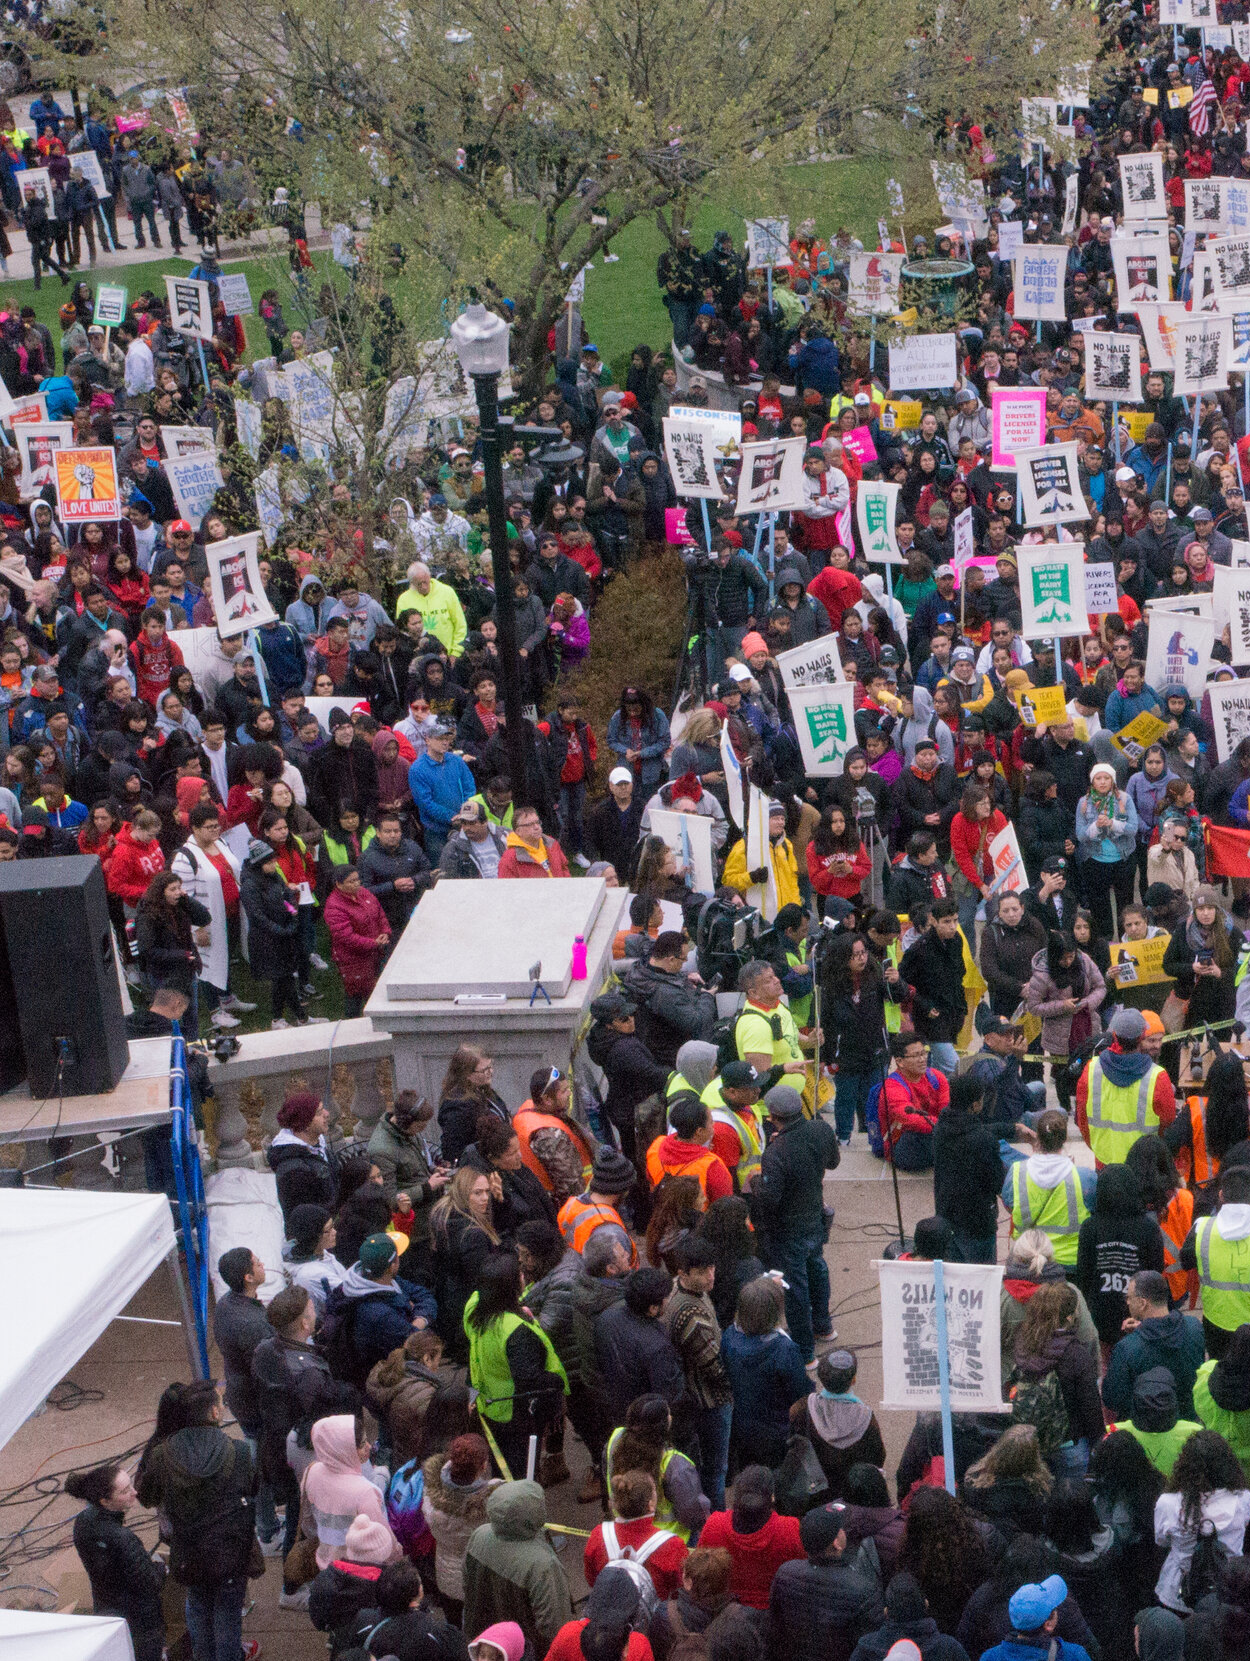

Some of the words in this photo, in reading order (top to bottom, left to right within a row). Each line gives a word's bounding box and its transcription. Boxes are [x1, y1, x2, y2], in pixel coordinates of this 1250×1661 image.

[1135, 163, 1153, 172] WALLS
[1202, 184, 1220, 192] WALLS
[1215, 246, 1226, 254] NO
[1227, 242, 1249, 251] WALLS
[1127, 259, 1157, 269] ABOLISH
[1137, 271, 1149, 279] ICE
[1185, 335, 1198, 343] NO
[1199, 332, 1221, 343] WALLS
[1234, 332, 1247, 340] FOR
[1093, 343, 1105, 351] NO
[1106, 344, 1130, 353] WALLS
[673, 408, 742, 422] WISCONSIN
[671, 433, 680, 442] NO
[682, 433, 704, 444] WALLS
[29, 441, 61, 449] ABOLISH
[1034, 460, 1061, 469] DRIVER
[1034, 470, 1066, 480] LICENSES
[1037, 481, 1052, 489] FOR
[64, 502, 89, 514] LOVE
[1091, 598, 1111, 606] ALL!
[791, 665, 806, 679] NO
[806, 653, 832, 671] WALLS
[1175, 675, 1184, 683] ALL
[1040, 701, 1061, 709] DRIVER
[1221, 700, 1232, 711] NO
[816, 721, 838, 730] DAIRY
[819, 729, 840, 738] STATE
